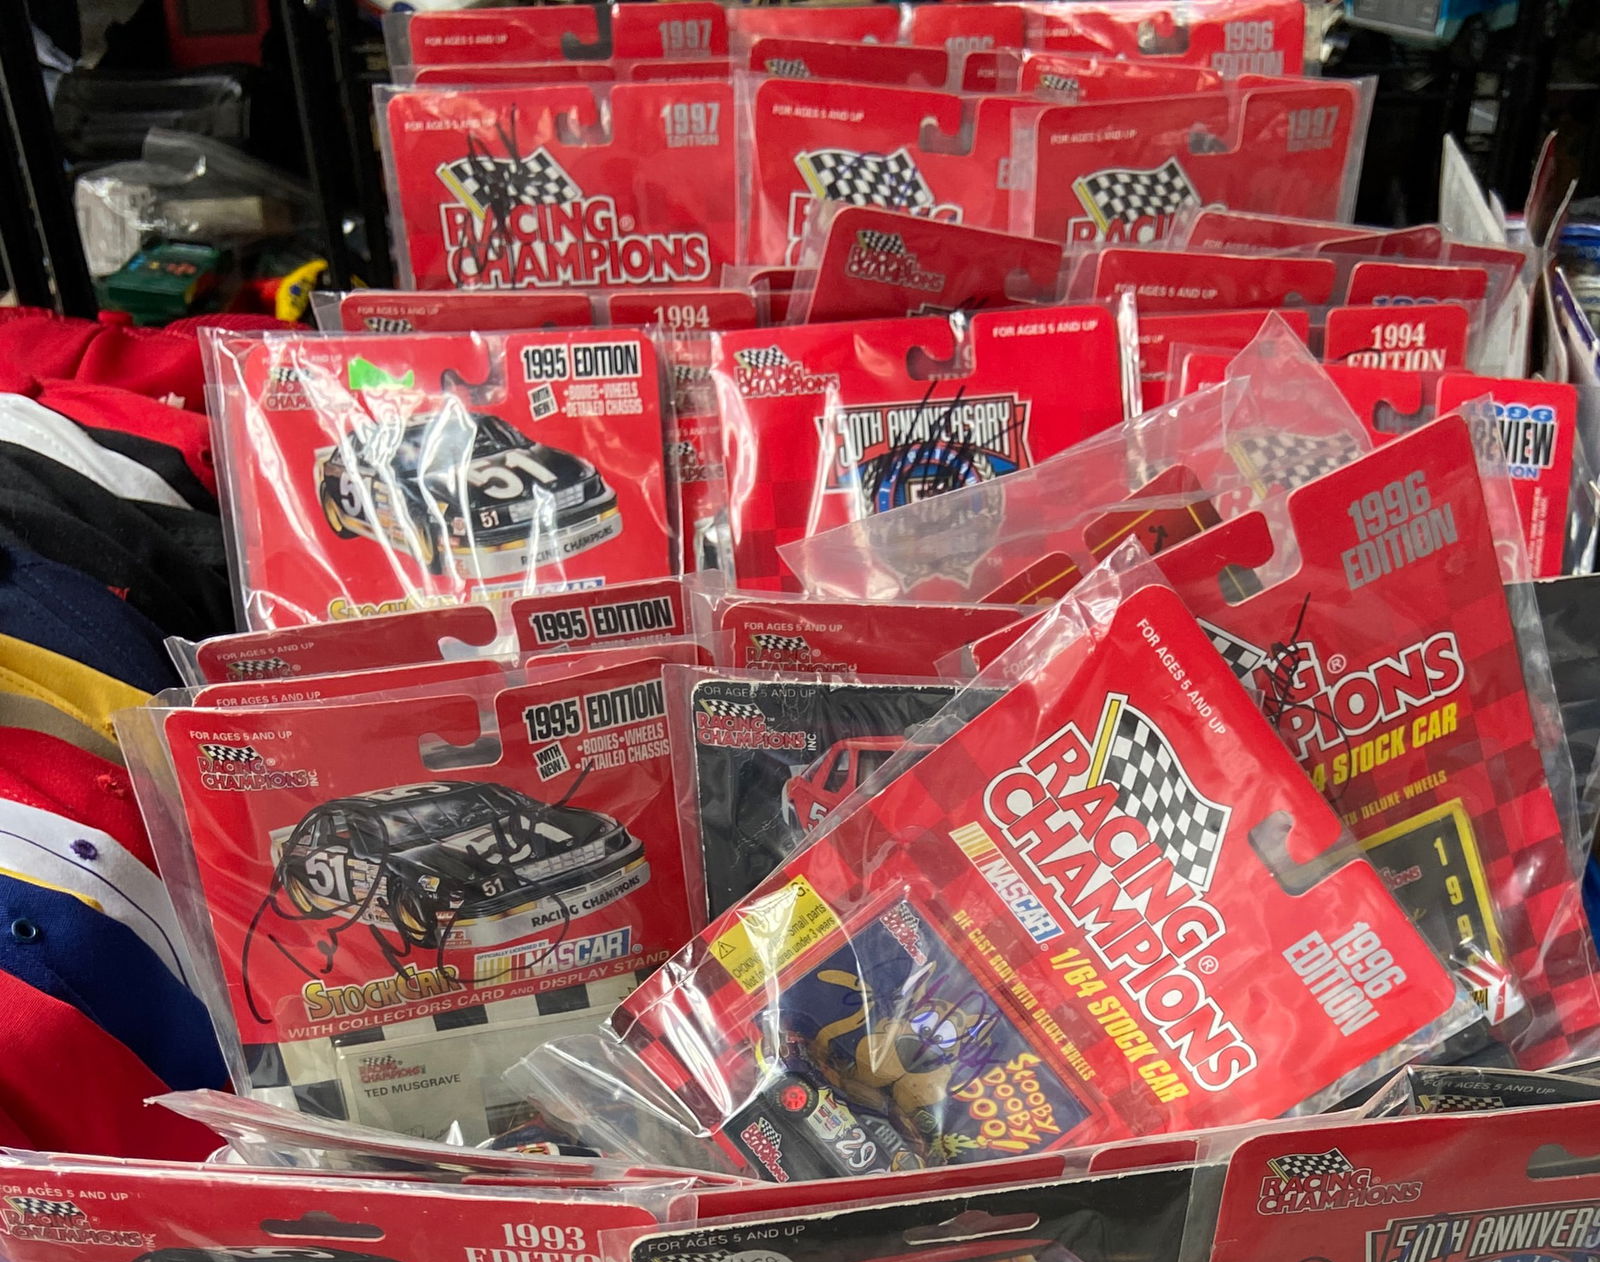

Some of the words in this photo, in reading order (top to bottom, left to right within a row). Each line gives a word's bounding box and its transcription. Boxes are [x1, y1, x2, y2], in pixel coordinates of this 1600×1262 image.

[659, 20, 712, 48] 1997
[1224, 22, 1273, 50] 1996
[661, 102, 720, 134] 1997
[1288, 107, 1338, 138] 1997
[443, 198, 617, 249] RACING
[448, 233, 711, 288] CHAMPIONS
[1138, 285, 1166, 297] AGES
[1177, 287, 1199, 299] AND
[1202, 289, 1218, 299] UP
[357, 306, 374, 315] FOR
[653, 305, 711, 329] 1994
[993, 326, 1014, 338] FOR
[1017, 325, 1045, 336] AGES
[1056, 322, 1082, 333] AND
[1084, 320, 1098, 331] UP
[1371, 323, 1426, 349] 1994
[524, 348, 567, 380] 1995
[574, 344, 639, 377] EDITION
[1347, 349, 1446, 371] EDITION
[468, 447, 558, 501] 51
[480, 510, 500, 528] 51
[1347, 470, 1432, 543] 1996
[1341, 503, 1459, 591] EDITION
[532, 611, 588, 644] 1995
[592, 598, 674, 637] EDITION
[744, 622, 763, 632] FOR
[767, 622, 793, 632] AGES
[805, 623, 827, 633] AND
[829, 623, 843, 633] UP
[217, 651, 237, 662] FOR
[239, 648, 266, 660] AGES
[277, 644, 299, 655] AND
[300, 641, 315, 651] UP
[1136, 618, 1161, 647] FOR
[1155, 646, 1185, 680] AGES
[1180, 679, 1193, 691] 5
[1187, 690, 1213, 717] AND
[1208, 716, 1227, 735] UP
[216, 697, 238, 708] FOR
[239, 696, 270, 707] AGES
[280, 692, 304, 703] AND
[306, 690, 321, 701] UP
[771, 688, 796, 698] AND
[799, 688, 817, 699] UP
[525, 700, 582, 742] 1995
[586, 679, 666, 731] EDITION
[190, 730, 211, 741] FOR
[212, 732, 241, 742] AGES
[252, 732, 276, 741] AND
[277, 730, 292, 740] UP
[583, 732, 619, 756] BODIES
[624, 722, 665, 748] WHEELS
[697, 730, 807, 751] CHAMPIONS
[1332, 725, 1407, 785] STOCK
[1413, 704, 1459, 749] CAR
[197, 755, 265, 775] RACING
[537, 744, 562, 765] WITH
[628, 739, 671, 764] CHASSIS
[201, 770, 309, 791] CHAMPIONS
[1030, 740, 1223, 961] RACING
[305, 850, 352, 902] 51
[480, 876, 506, 898] 51
[581, 873, 641, 911] CHAMPIONS
[980, 858, 1058, 942] NASCAR
[985, 768, 1257, 1090] CHAMPIONS
[525, 932, 623, 977] NASCAR
[1332, 920, 1407, 1000] 1996
[288, 1024, 334, 1040] WITH
[338, 999, 453, 1033] COLLECTORS
[457, 989, 505, 1007] CARD
[510, 985, 534, 997] AND
[540, 965, 608, 991] DISPLAY
[613, 949, 670, 974] STAND
[952, 909, 975, 931] DIE
[968, 927, 997, 956] CAST
[1062, 1042, 1097, 1082] WHEELS
[1281, 930, 1381, 1037] EDITION
[1050, 947, 1108, 998] 1/64
[1092, 994, 1155, 1068] STOCK
[1138, 1060, 1189, 1104] CAR
[364, 1085, 390, 1099] TED
[391, 1074, 461, 1096] MUSGRAVE
[1455, 1081, 1490, 1090] AGES
[1503, 1084, 1534, 1093] AND
[1536, 1087, 1556, 1095] UP
[27, 1187, 63, 1198] AGES
[80, 1190, 106, 1200] AND
[110, 1191, 129, 1201] UP
[1262, 1169, 1372, 1197] RACING
[1258, 1182, 1423, 1215] CHAMPIONS
[9, 1225, 143, 1247] CHAMPIONS
[502, 1222, 588, 1251] 1993
[649, 1241, 681, 1253] FOR
[686, 1236, 728, 1249] AGES
[747, 1229, 779, 1240] AND
[785, 1225, 806, 1236] UP
